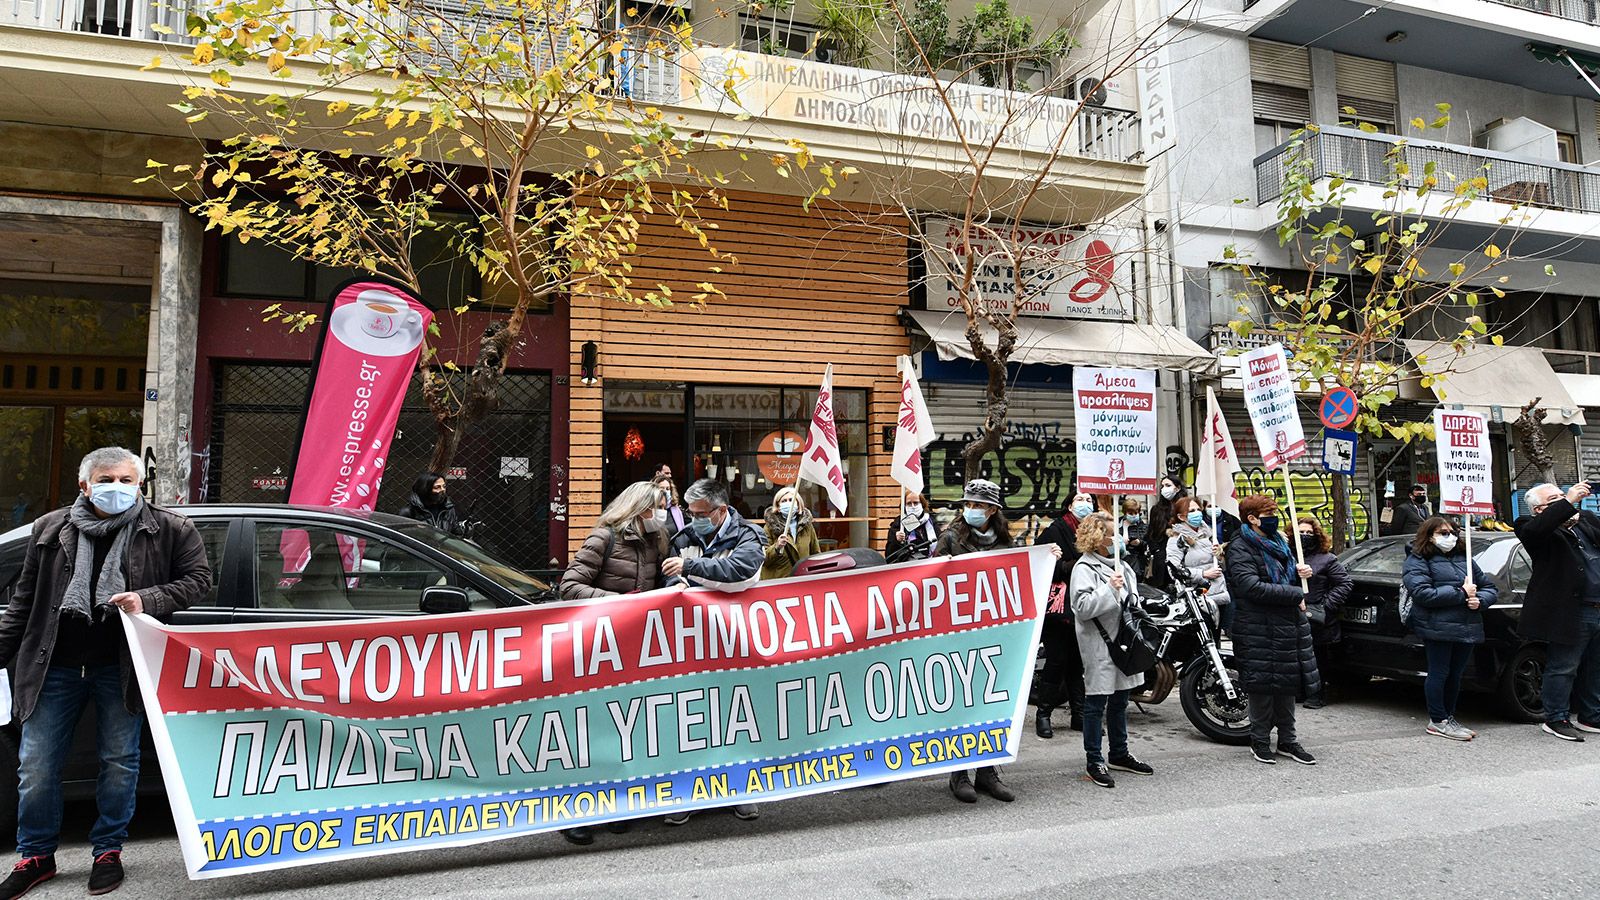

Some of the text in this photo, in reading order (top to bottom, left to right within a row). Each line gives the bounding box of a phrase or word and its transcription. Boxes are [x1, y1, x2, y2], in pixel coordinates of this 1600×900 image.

[754, 60, 861, 94] ΠΑΝΕΛΛΗΝΙΑ
[794, 97, 888, 128] ΔΗΜΟΣΙΩΝ
[984, 299, 1008, 310] ΤΩΝ
[1066, 306, 1093, 315] ΠΑΝΟΣ
[1094, 373, 1136, 390] Άμεσα
[1081, 392, 1149, 410] προσλήψεις
[1093, 411, 1138, 425] μόνιμων
[1446, 417, 1483, 431] ΔΩΡΕΑΝ
[1089, 425, 1142, 438] σχολικών
[1453, 432, 1478, 446] ΤΕΣΤ
[1081, 440, 1151, 455] καθαριστριών
[541, 615, 623, 683] ΓΙΑ
[638, 591, 854, 669] ΔΗΜΟΣΙΑ
[865, 566, 1024, 640] ΔΩΡΕΑΝ
[213, 645, 1009, 798] ΠΑΙΔΕΙΑ ΚΑΙ ΥΓΕΙΑ ΓΙΑ ΟΛΟΥΣ
[352, 788, 617, 847] ΕΚΠΑΙΔΕΥΤΙΚΩΝ
[627, 783, 679, 813] Π.Ε.
[690, 774, 738, 803] ΑΝ.
[746, 753, 858, 795] ΑΤΤΙΚΗΣ
[883, 745, 902, 770] Ο
